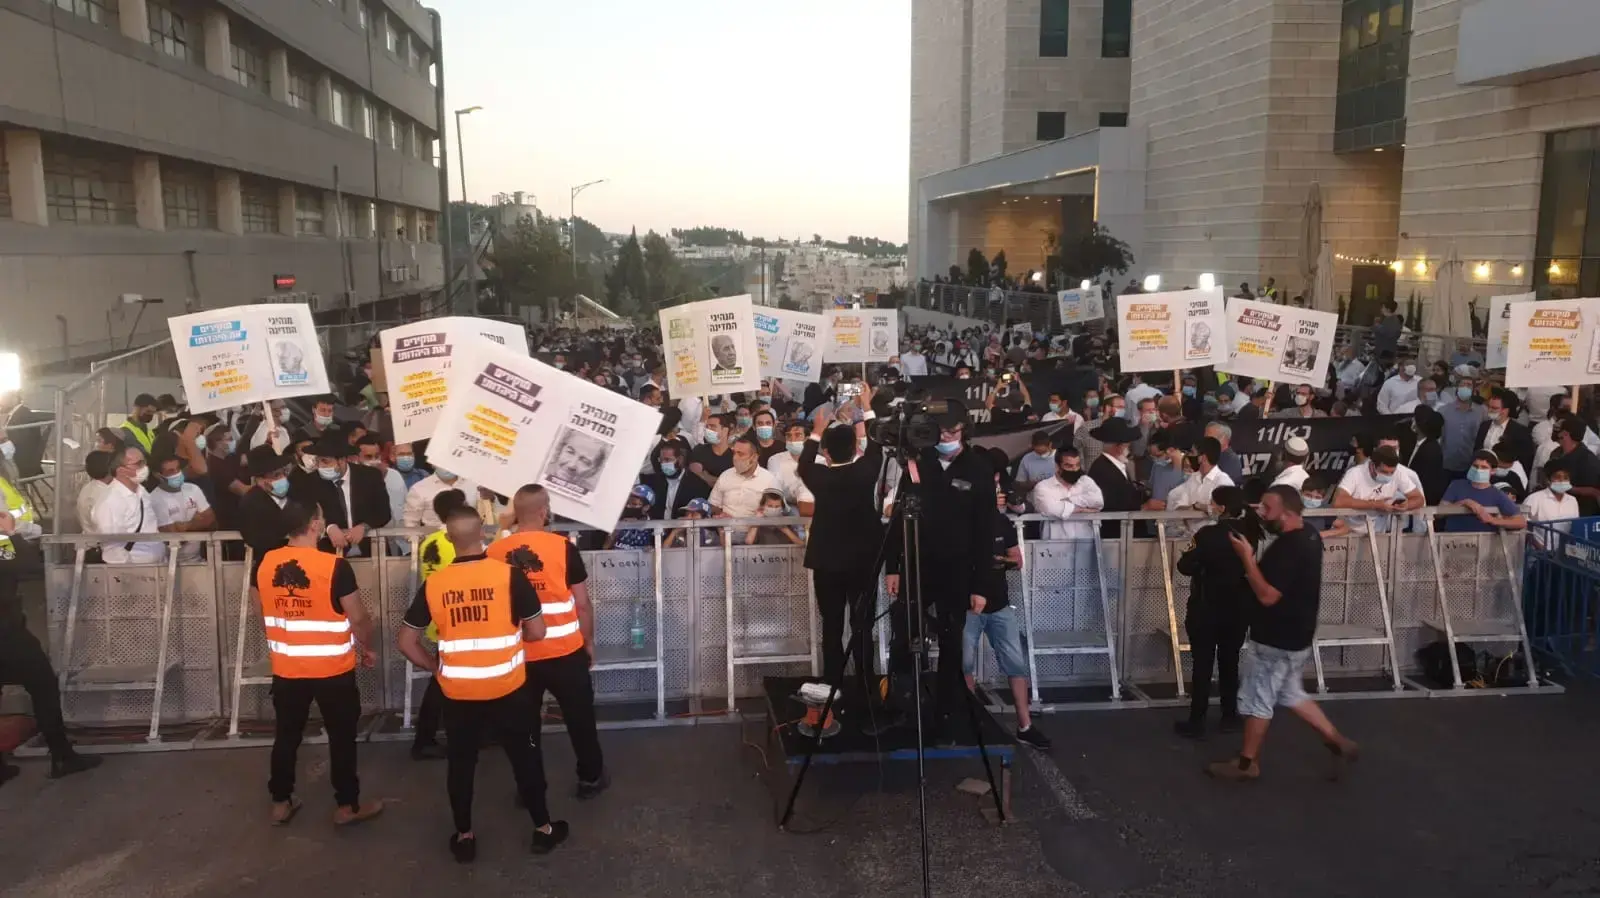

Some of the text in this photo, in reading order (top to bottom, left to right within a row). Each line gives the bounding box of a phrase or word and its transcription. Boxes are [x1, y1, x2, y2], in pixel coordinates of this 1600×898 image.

[268, 316, 293, 325] מנהיגי
[710, 312, 735, 321] מנהיגי
[268, 326, 298, 335] המדינה
[709, 322, 738, 333] המדינה
[1299, 327, 1315, 336] עולם
[403, 334, 437, 347] מוקירים
[432, 346, 447, 354] את
[493, 367, 532, 390] מוקירים
[580, 401, 618, 425] מנהיגי
[570, 414, 617, 438] המדינה
[1257, 427, 1275, 442] 11
[274, 597, 313, 609] צוות אלון
[442, 587, 494, 608] צוות אלון
[449, 605, 489, 627] בטחון
